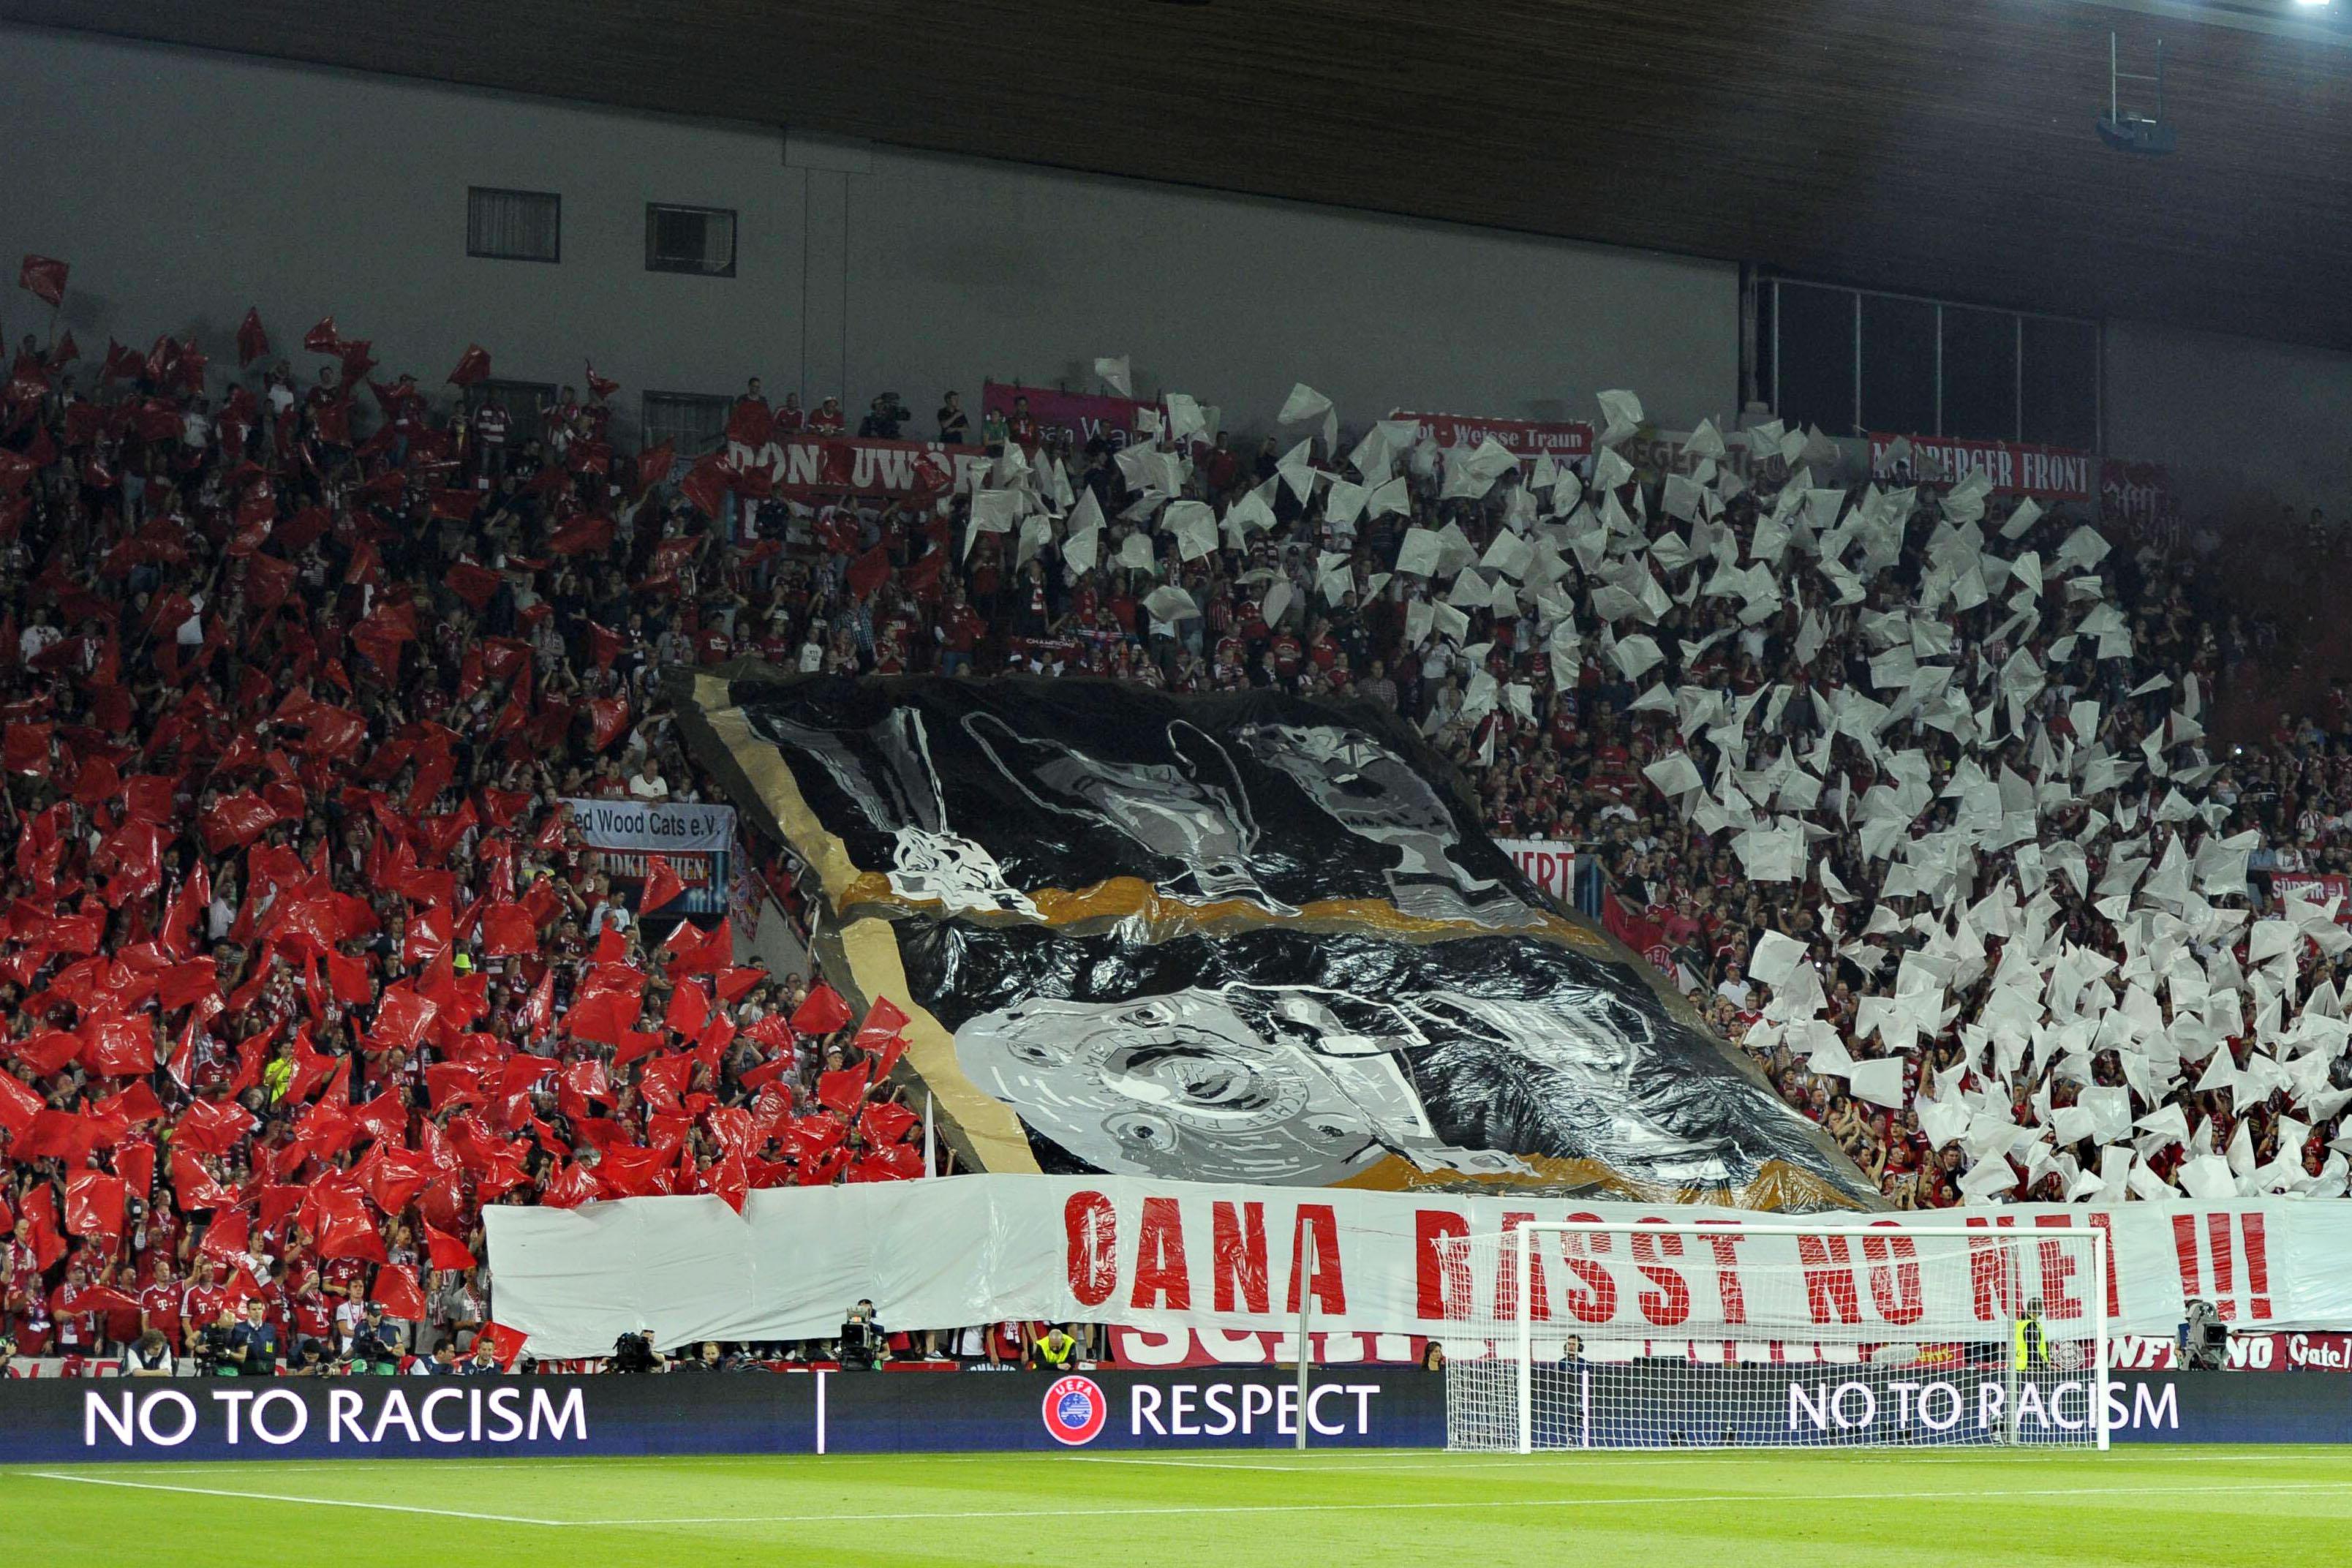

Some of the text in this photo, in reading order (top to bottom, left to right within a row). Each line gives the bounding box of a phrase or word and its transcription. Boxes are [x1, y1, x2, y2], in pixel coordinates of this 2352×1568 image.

[1526, 429, 1583, 448] Traun
[2021, 453, 2089, 494] FRONT
[598, 809, 644, 834] Wood
[649, 813, 685, 836] Cats
[690, 815, 720, 837] e.V.
[1065, 1190, 1346, 1315] OANA
[1415, 1210, 1747, 1326] BASST
[1797, 1220, 1924, 1326] NO
[1966, 1213, 2120, 1322] NEI
[1055, 1380, 1093, 1396] UEFA
[1131, 1384, 1381, 1436] RESPECT
[1789, 1381, 2179, 1431] NO TO RACISM
[84, 1388, 587, 1447] NO TO RACISM
